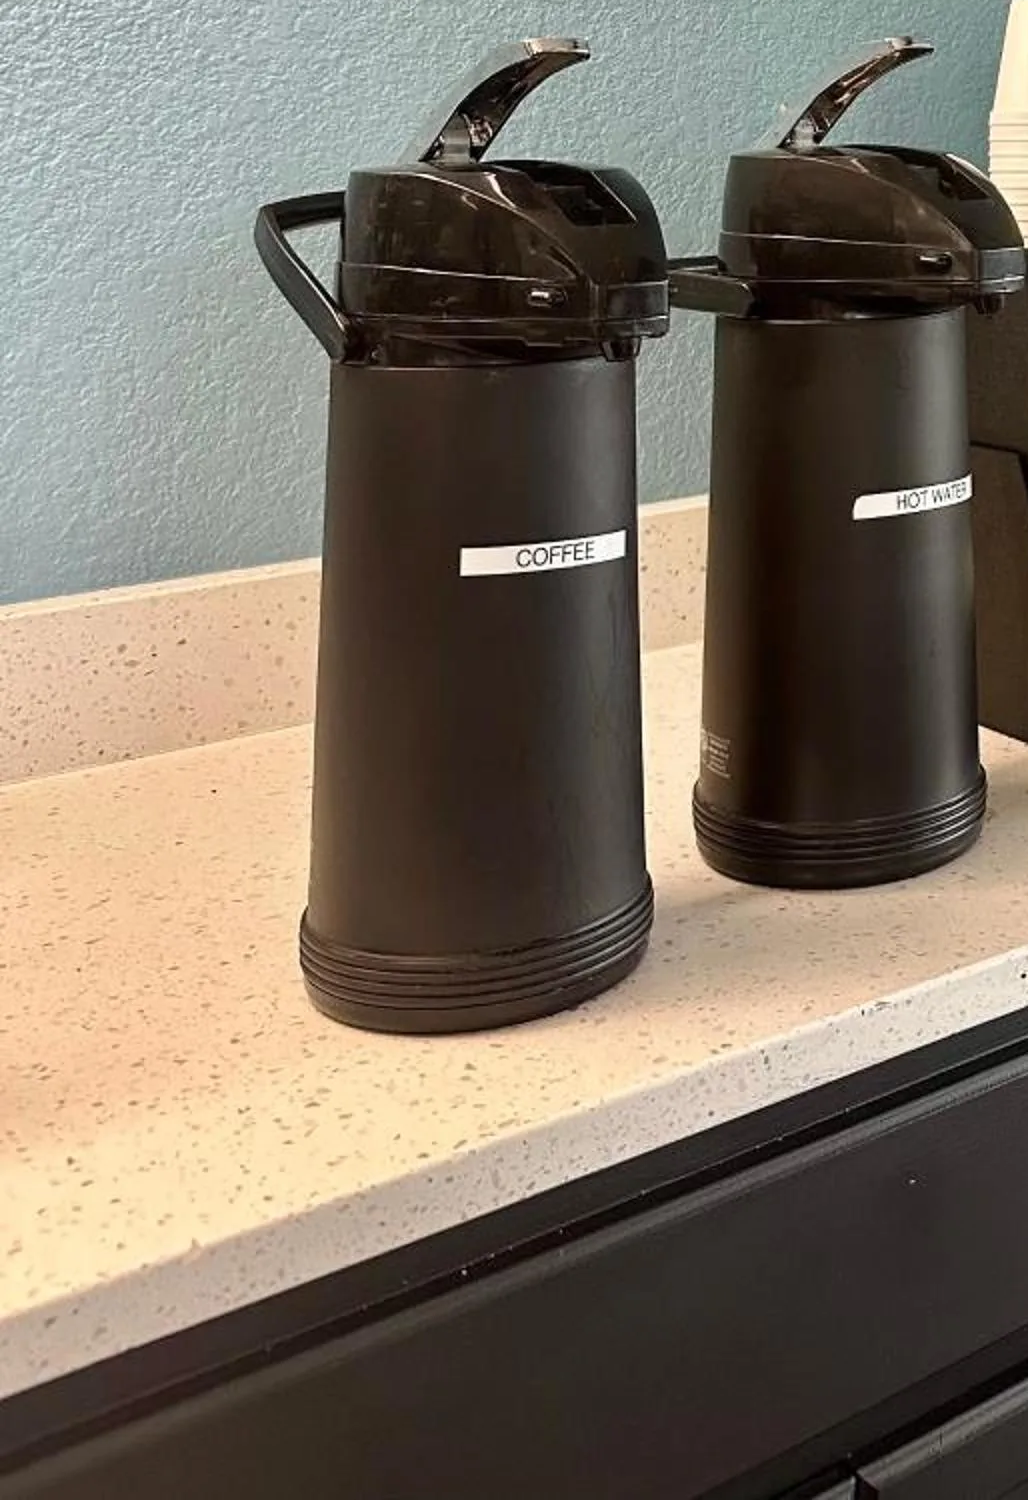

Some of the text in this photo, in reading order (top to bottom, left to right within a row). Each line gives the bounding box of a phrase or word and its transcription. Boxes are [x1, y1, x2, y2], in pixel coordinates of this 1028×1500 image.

[896, 481, 967, 509] HOT WATER
[516, 540, 596, 568] COFFEE
